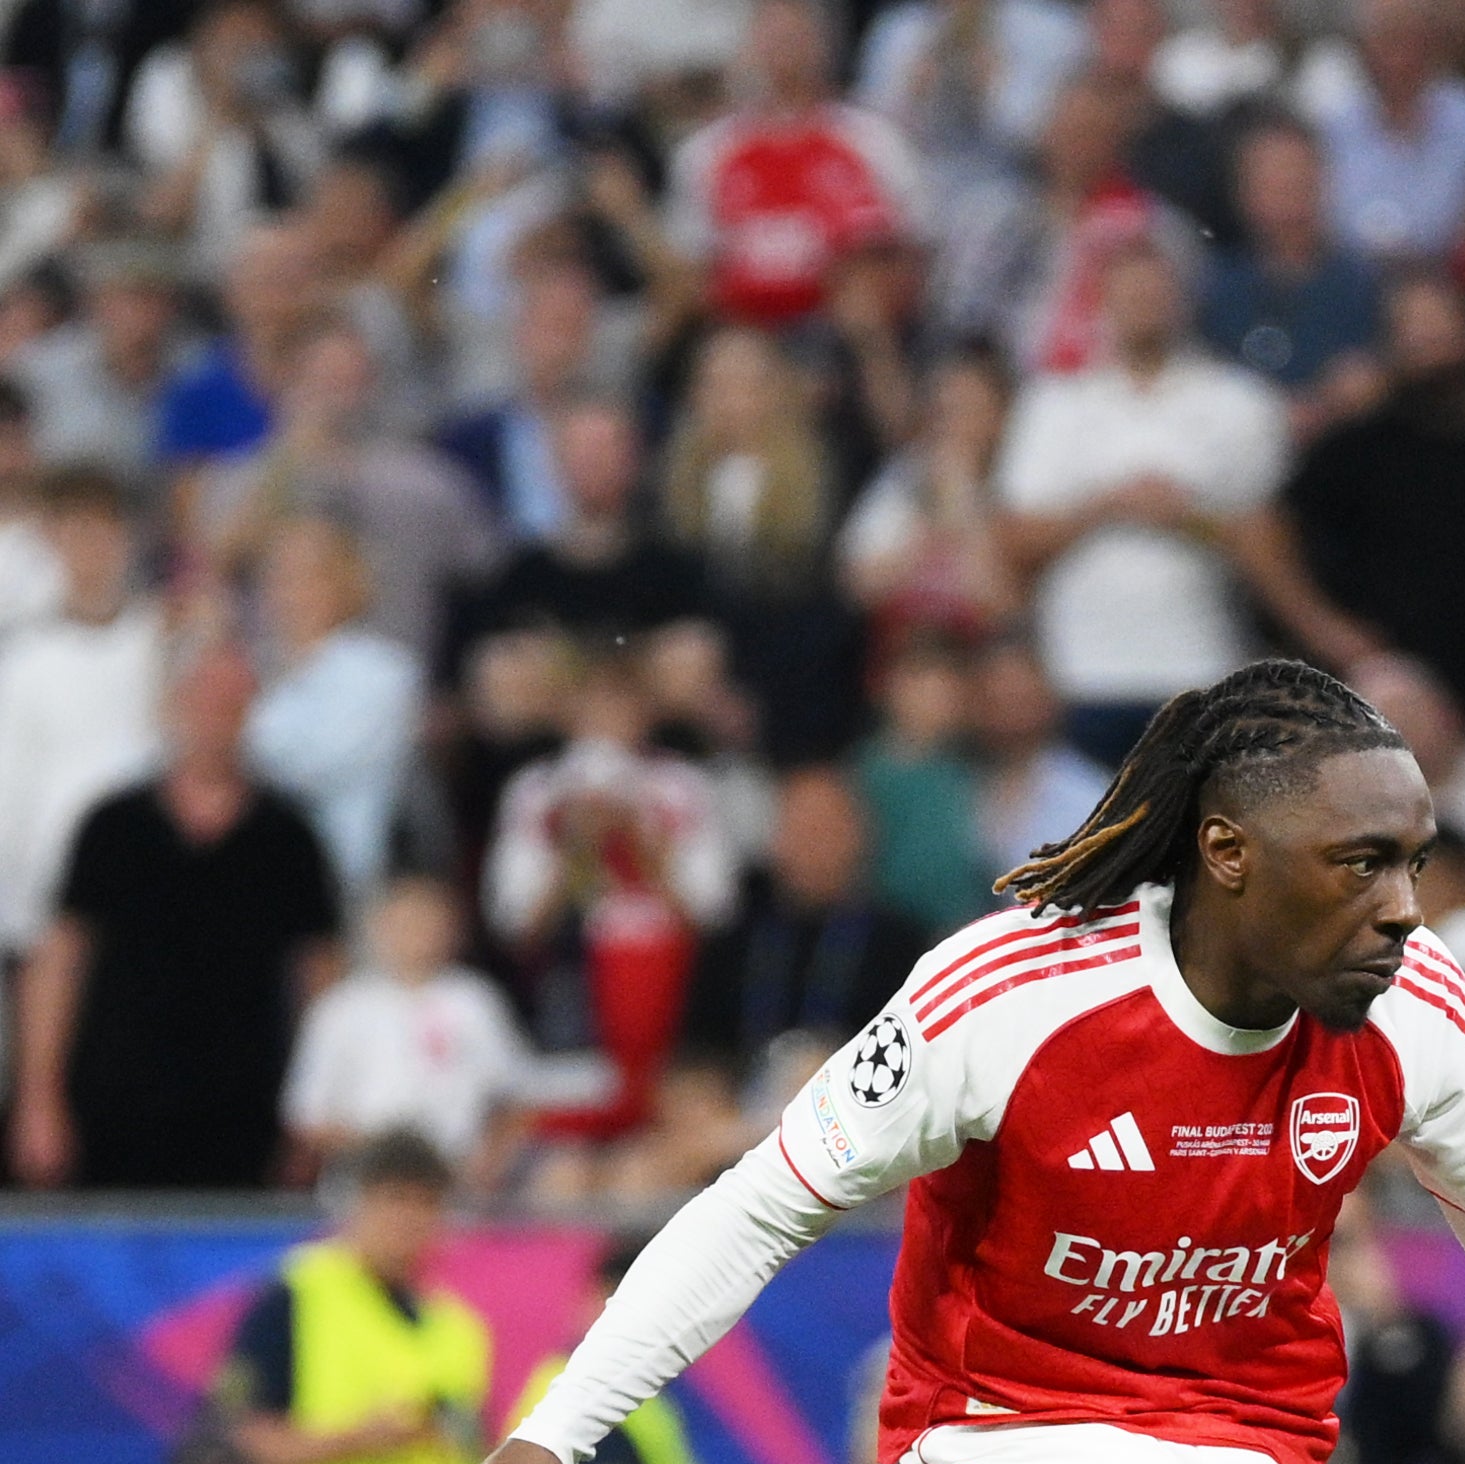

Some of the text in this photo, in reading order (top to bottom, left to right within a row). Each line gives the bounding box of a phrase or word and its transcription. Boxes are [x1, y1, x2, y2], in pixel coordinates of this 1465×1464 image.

[1301, 1109, 1350, 1124] Arsenal
[1171, 1125, 1203, 1138] FINAL
[1044, 1228, 1316, 1292] Emirat
[1071, 1294, 1147, 1329] FLY
